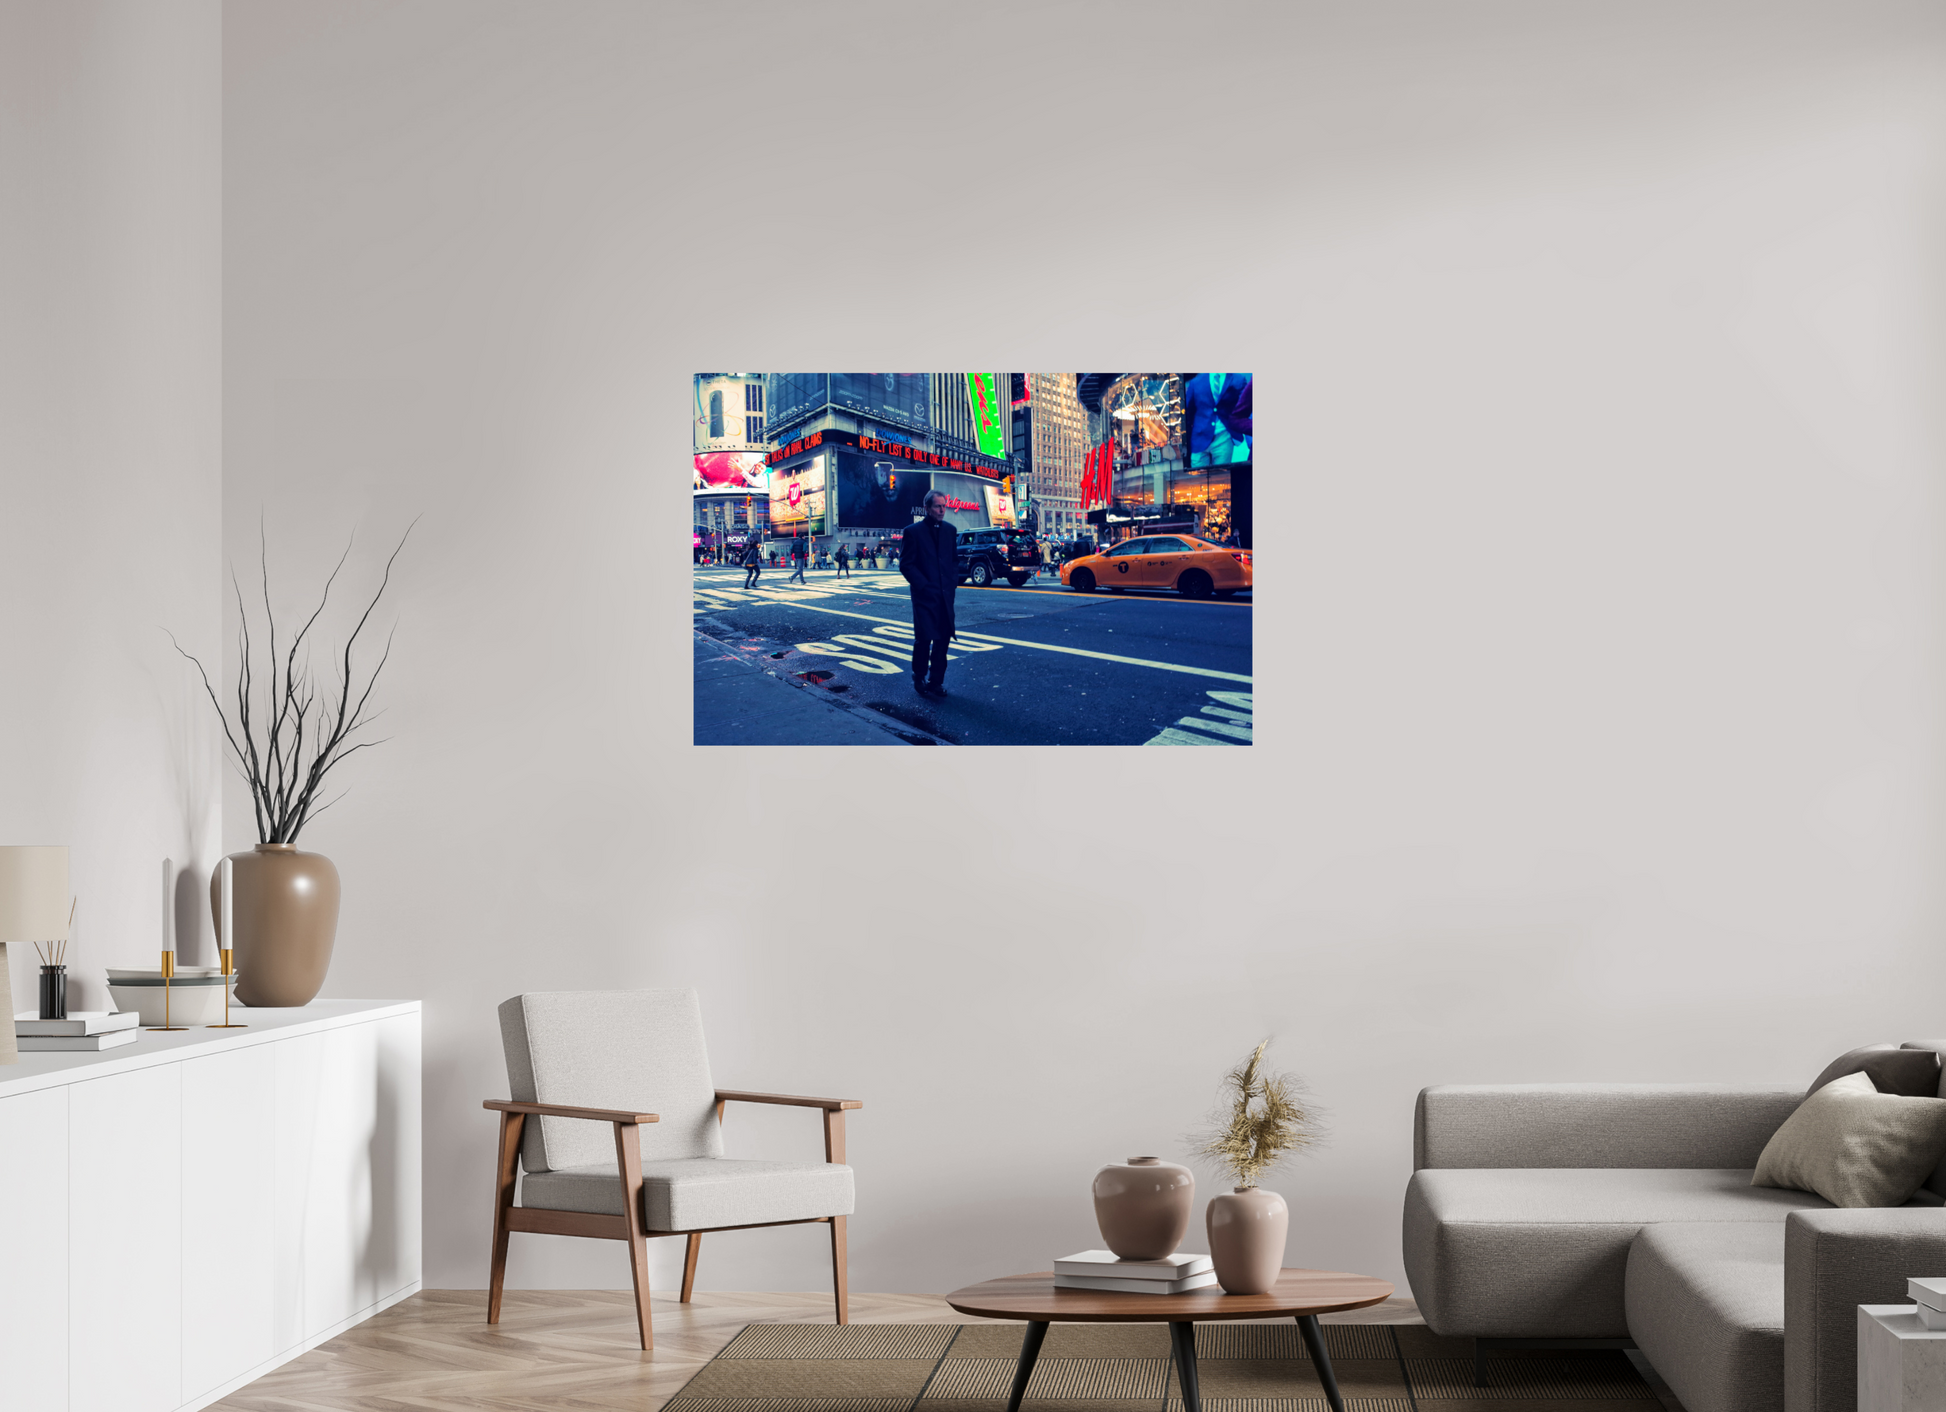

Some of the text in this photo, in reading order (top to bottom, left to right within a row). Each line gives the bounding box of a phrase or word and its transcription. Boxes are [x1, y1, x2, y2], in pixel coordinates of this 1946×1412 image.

[860, 435, 885, 453] NO-FLY
[889, 443, 902, 457] LIST
[905, 447, 911, 459] IS
[913, 449, 927, 462] ONLY
[929, 453, 940, 466] ONE
[942, 456, 949, 467] OF
[1081, 437, 1114, 510] H&M
